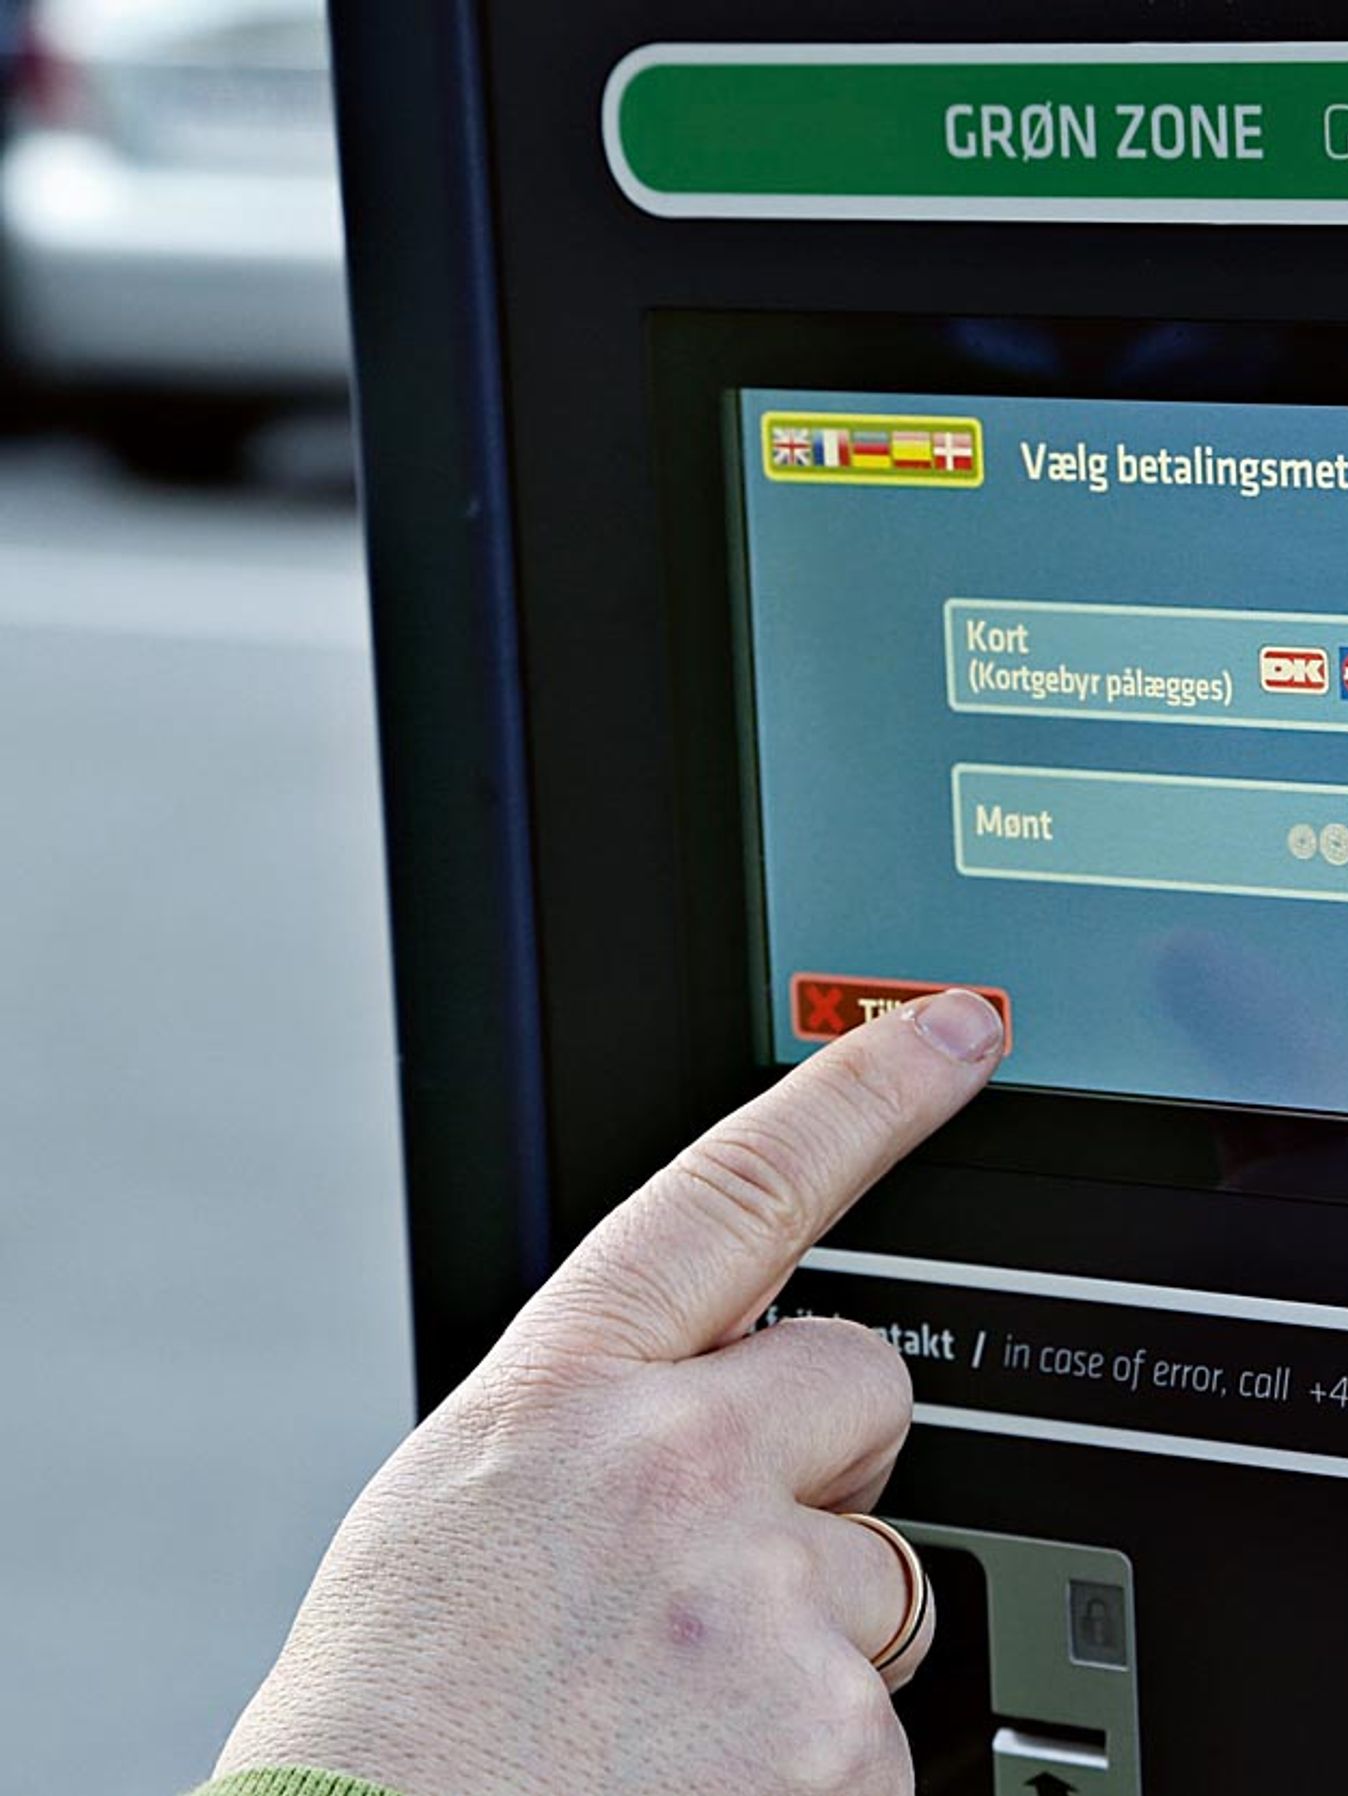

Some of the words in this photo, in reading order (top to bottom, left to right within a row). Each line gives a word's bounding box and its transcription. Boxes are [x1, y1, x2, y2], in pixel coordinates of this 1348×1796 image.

[945, 102, 1097, 161] GRØN
[1116, 104, 1264, 160] ZONE
[1020, 441, 1107, 492] Vælg
[966, 619, 1029, 655] Kort
[968, 662, 1100, 701] (Kortgebyr
[1106, 669, 1233, 707] pålægges)
[975, 804, 1053, 841] Mønt
[1003, 1334, 1031, 1369] in
[1039, 1345, 1103, 1379] case
[1112, 1349, 1146, 1391] of
[1152, 1358, 1228, 1396] error,
[1239, 1366, 1292, 1401] call
